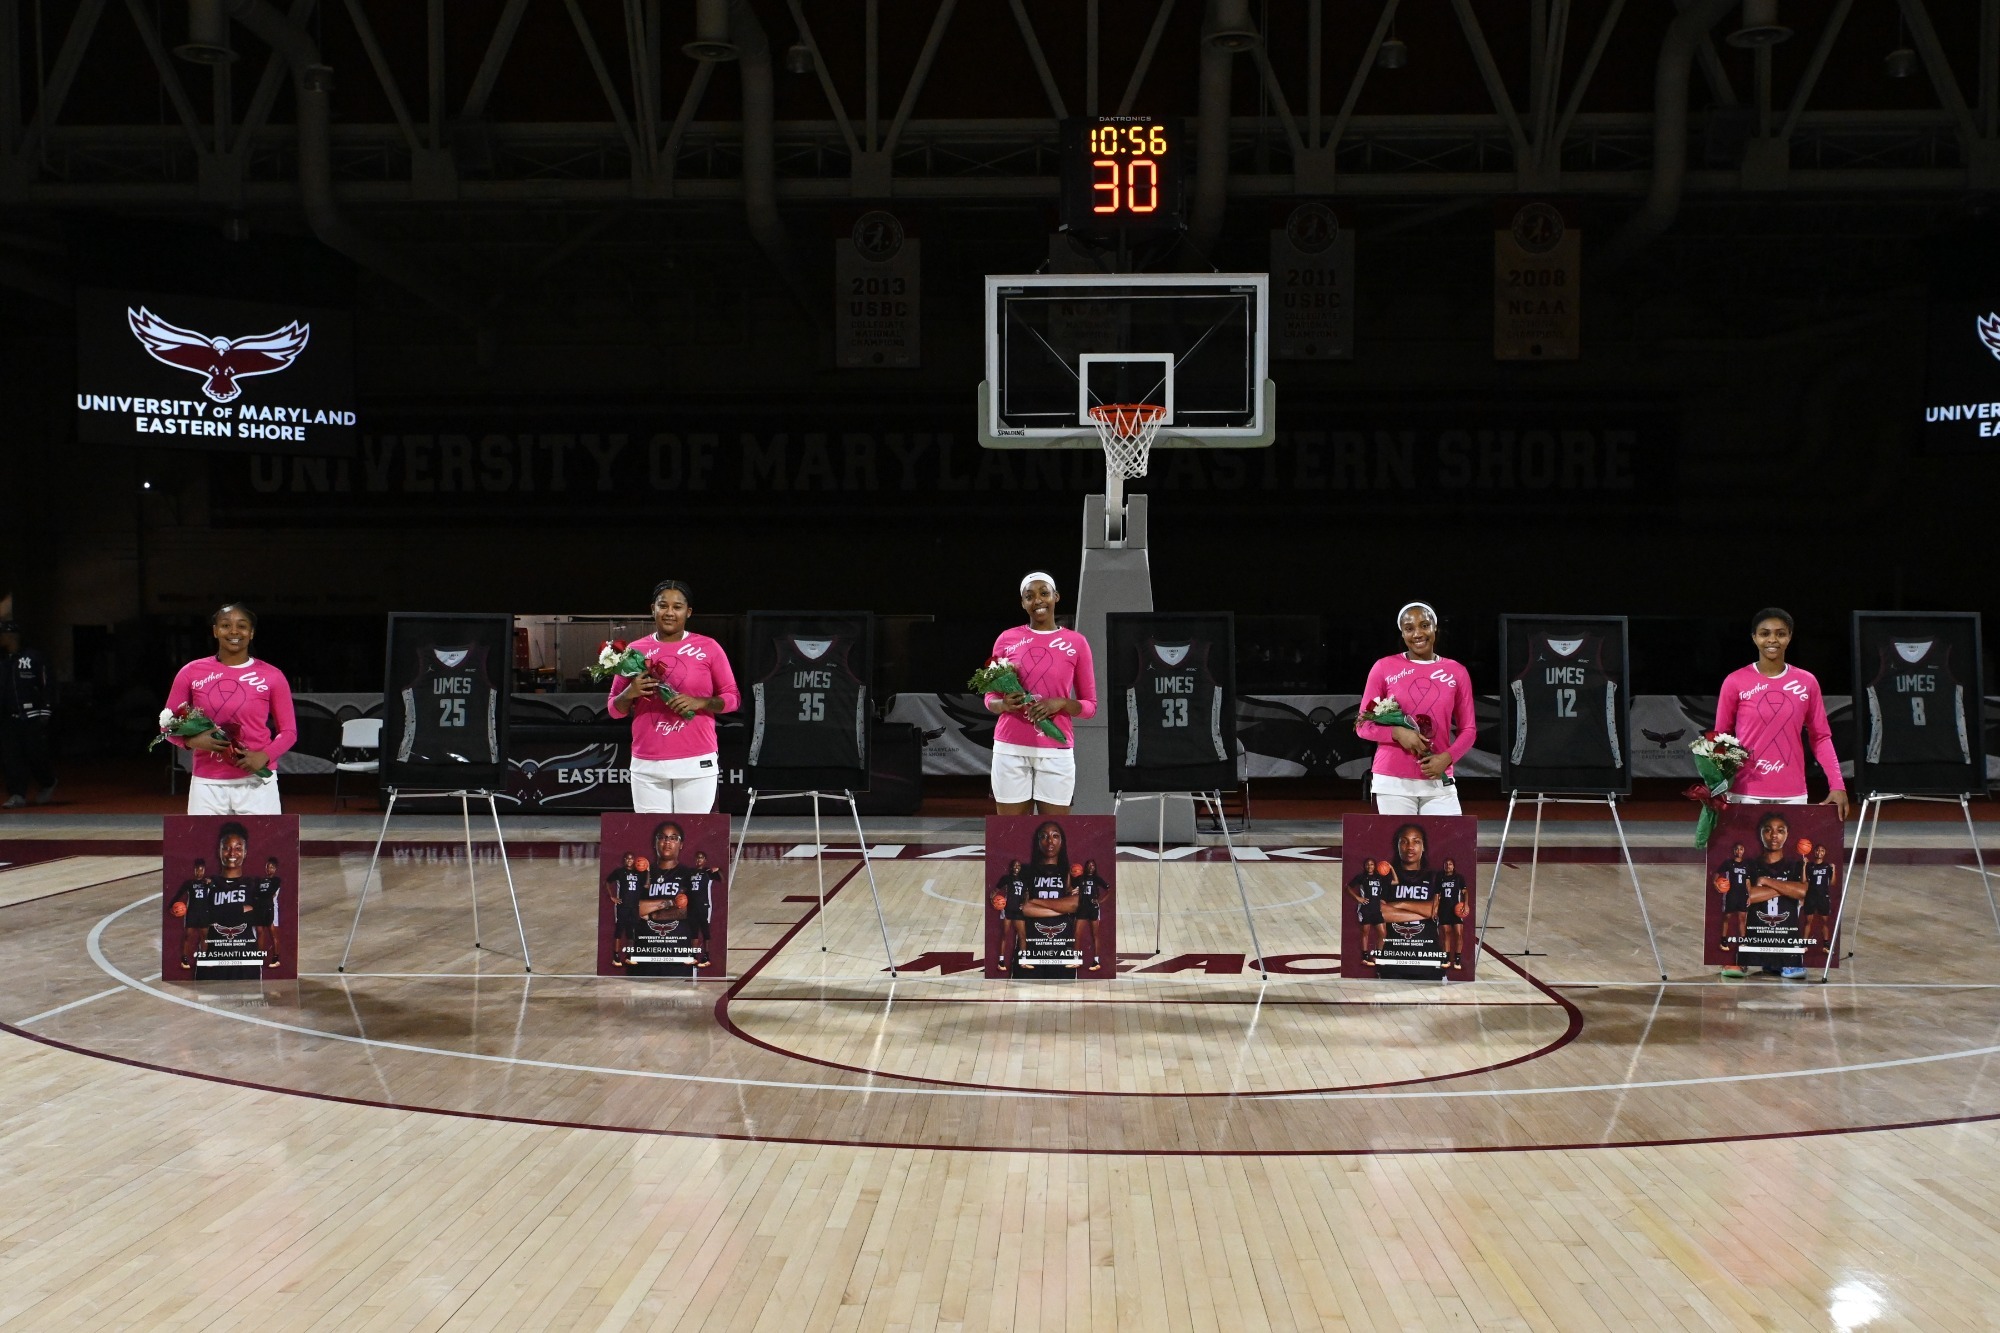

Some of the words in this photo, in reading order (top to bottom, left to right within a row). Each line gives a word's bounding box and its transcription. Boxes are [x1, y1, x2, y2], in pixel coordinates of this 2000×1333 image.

[1091, 125, 1167, 156] 10:56
[1093, 159, 1158, 213] 30
[852, 277, 906, 296] 2013
[1287, 268, 1336, 287] 2011
[1508, 268, 1567, 288] 2008
[850, 301, 908, 318] USBC
[1284, 292, 1341, 309] USBC
[1508, 299, 1566, 316] NCAA
[77, 393, 207, 417] UNIVERSITY
[212, 405, 233, 419] OF
[239, 404, 358, 427] MARYLAND
[136, 416, 232, 438] EASTERN
[238, 422, 306, 442] SHORE
[997, 429, 1025, 437] SPALDING
[249, 432, 630, 492] UNIVERSITY
[648, 431, 720, 490] OF
[1124, 430, 1417, 490] ASTERN
[1436, 430, 1637, 489] SHORE
[677, 643, 708, 661] We
[1004, 637, 1034, 654] Together
[1048, 637, 1077, 657] We
[191, 671, 224, 690] Together
[238, 671, 269, 693] We
[793, 670, 832, 689] UMES
[1384, 667, 1415, 686] Together
[1429, 668, 1457, 688] We
[1545, 666, 1585, 685] UMES
[1896, 674, 1936, 693] UMES
[433, 676, 472, 695] UMES
[1154, 676, 1194, 695] UMES
[1739, 683, 1769, 701] Together
[1782, 680, 1809, 702] We
[798, 692, 826, 722] 35
[1556, 688, 1580, 718] 12
[1911, 696, 1927, 727] 8
[440, 698, 467, 728] 25
[1161, 698, 1190, 728] 33
[655, 720, 687, 737] Fight
[558, 768, 632, 784] EASTER
[1755, 759, 1786, 775] Fight
[649, 882, 680, 897] UMES
[1034, 876, 1063, 889] UMES
[194, 889, 204, 899] 25
[213, 889, 246, 906] UMES
[1395, 885, 1429, 900] UMES
[1738, 936, 1786, 944] DAYSHAWNA
[1060, 949, 1083, 957] ALLEN
